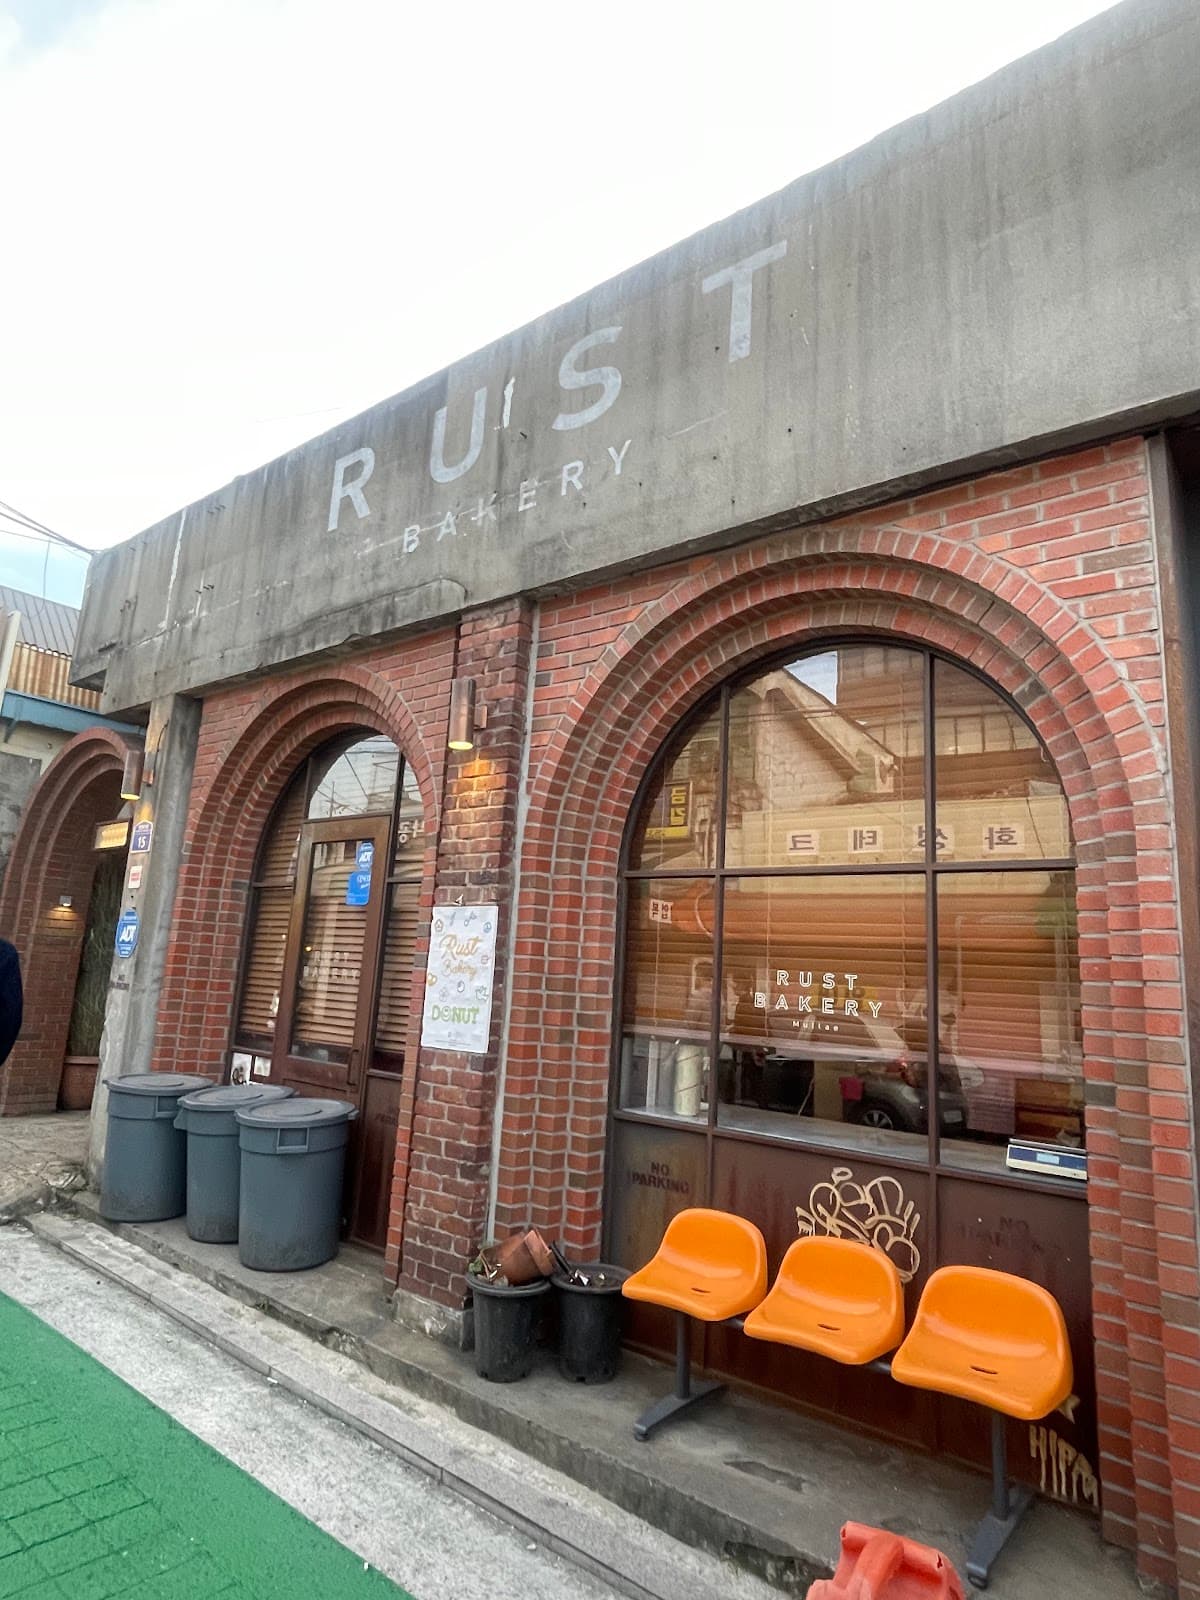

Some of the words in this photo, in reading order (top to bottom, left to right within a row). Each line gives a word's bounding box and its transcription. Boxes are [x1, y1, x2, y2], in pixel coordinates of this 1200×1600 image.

[327, 240, 787, 532] RUST
[403, 439, 632, 554] BAKERY
[138, 836, 147, 849] 15
[439, 933, 483, 961] Rust
[776, 969, 858, 991] RUST
[431, 1004, 480, 1025] DONUT
[754, 991, 883, 1018] BAKERY
[650, 1161, 670, 1177] NO
[631, 1170, 690, 1194] PARKING
